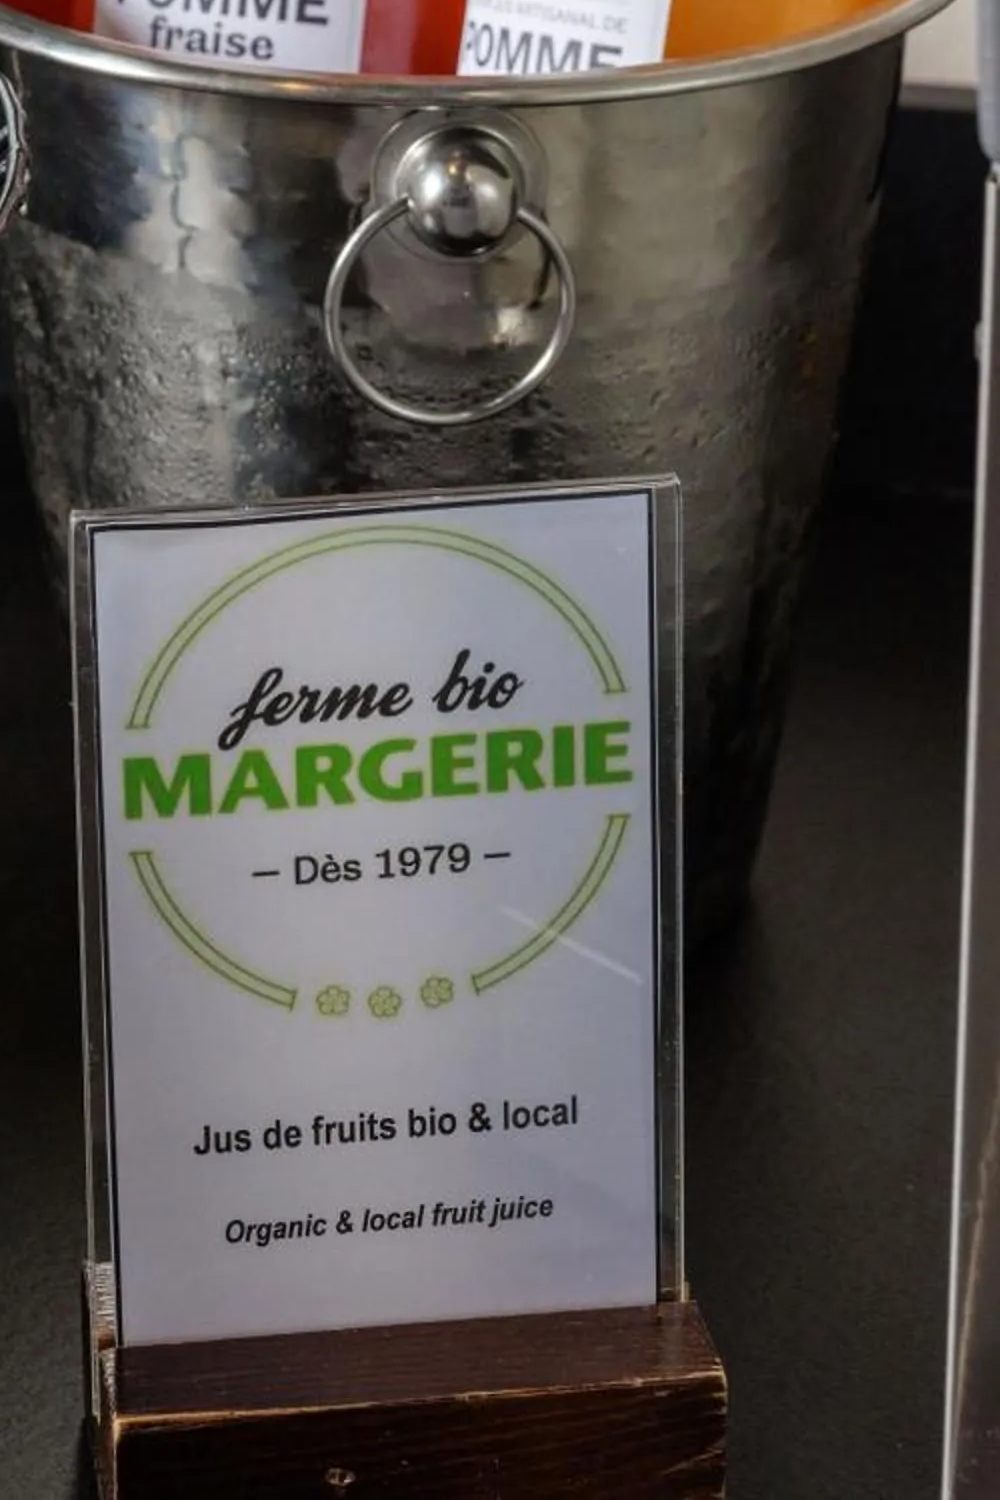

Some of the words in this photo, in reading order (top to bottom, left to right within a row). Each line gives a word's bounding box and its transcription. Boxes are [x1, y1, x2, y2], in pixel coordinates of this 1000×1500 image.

[150, 15, 275, 61] fraise
[218, 666, 413, 751] ferme
[433, 648, 524, 715] bio
[122, 720, 633, 820] MARGERIE
[293, 854, 362, 885] Dès
[374, 842, 472, 879] 1979
[193, 1124, 252, 1155] Jus
[263, 1119, 302, 1150] de
[312, 1112, 397, 1146] fruits
[408, 1106, 457, 1138] bio
[468, 1102, 493, 1133] &
[503, 1095, 578, 1130] local
[225, 1213, 327, 1247] Organic
[335, 1210, 354, 1235] &
[362, 1203, 425, 1232] local
[432, 1199, 486, 1227] fruit
[488, 1195, 554, 1228] juice
